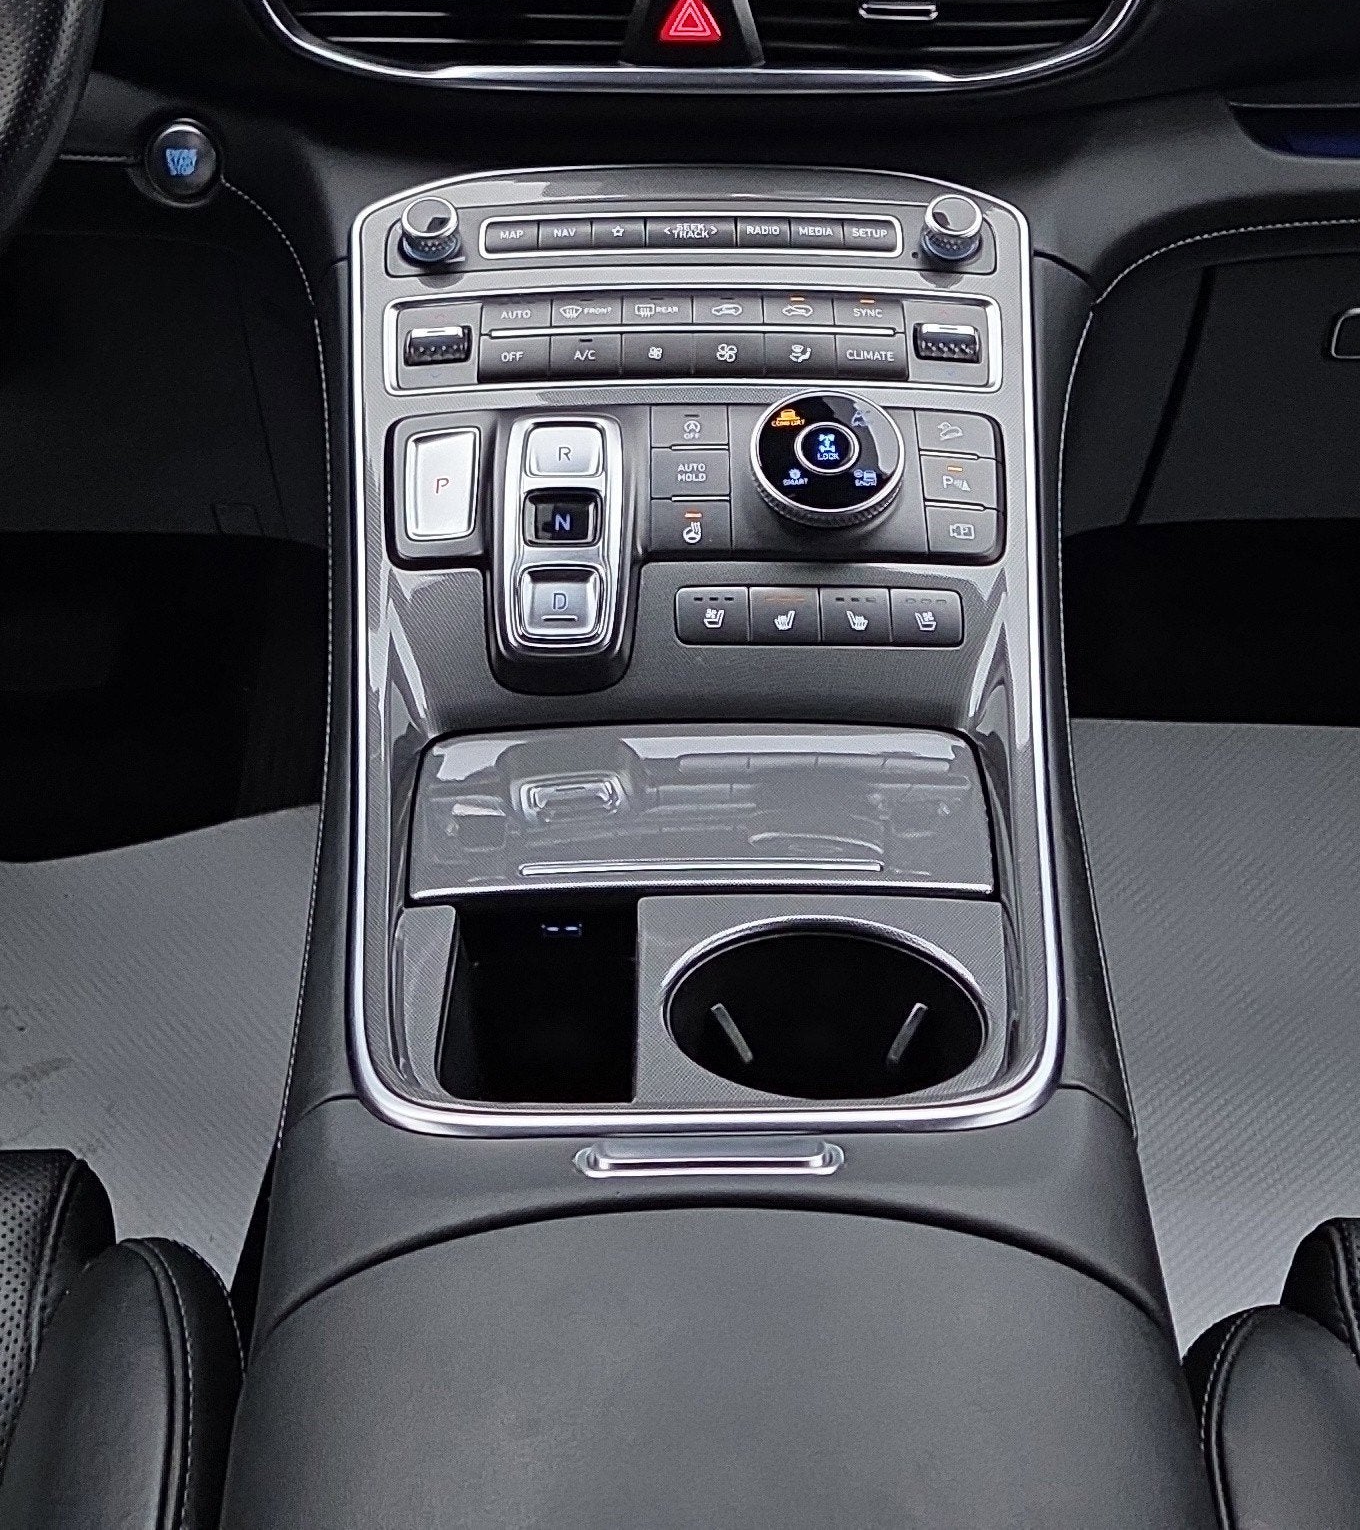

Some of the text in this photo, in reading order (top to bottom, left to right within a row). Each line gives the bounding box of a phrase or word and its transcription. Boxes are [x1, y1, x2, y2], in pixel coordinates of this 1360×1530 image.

[500, 230, 523, 240] MAP
[553, 228, 576, 237] NAV
[746, 225, 780, 235] RADIO
[798, 226, 834, 236] MEDIA
[852, 228, 888, 238] SETUP
[500, 310, 531, 320] AUTO
[853, 308, 883, 318] SYNC
[500, 352, 524, 362] OFF
[573, 350, 596, 361] A/C
[846, 350, 895, 362] CLIMATE
[558, 446, 572, 462] R
[817, 453, 839, 461] LOCK
[677, 463, 706, 472] AUTO
[677, 473, 707, 482] HOLD
[435, 477, 450, 494] P
[554, 514, 571, 531] N
[552, 592, 568, 610] D
